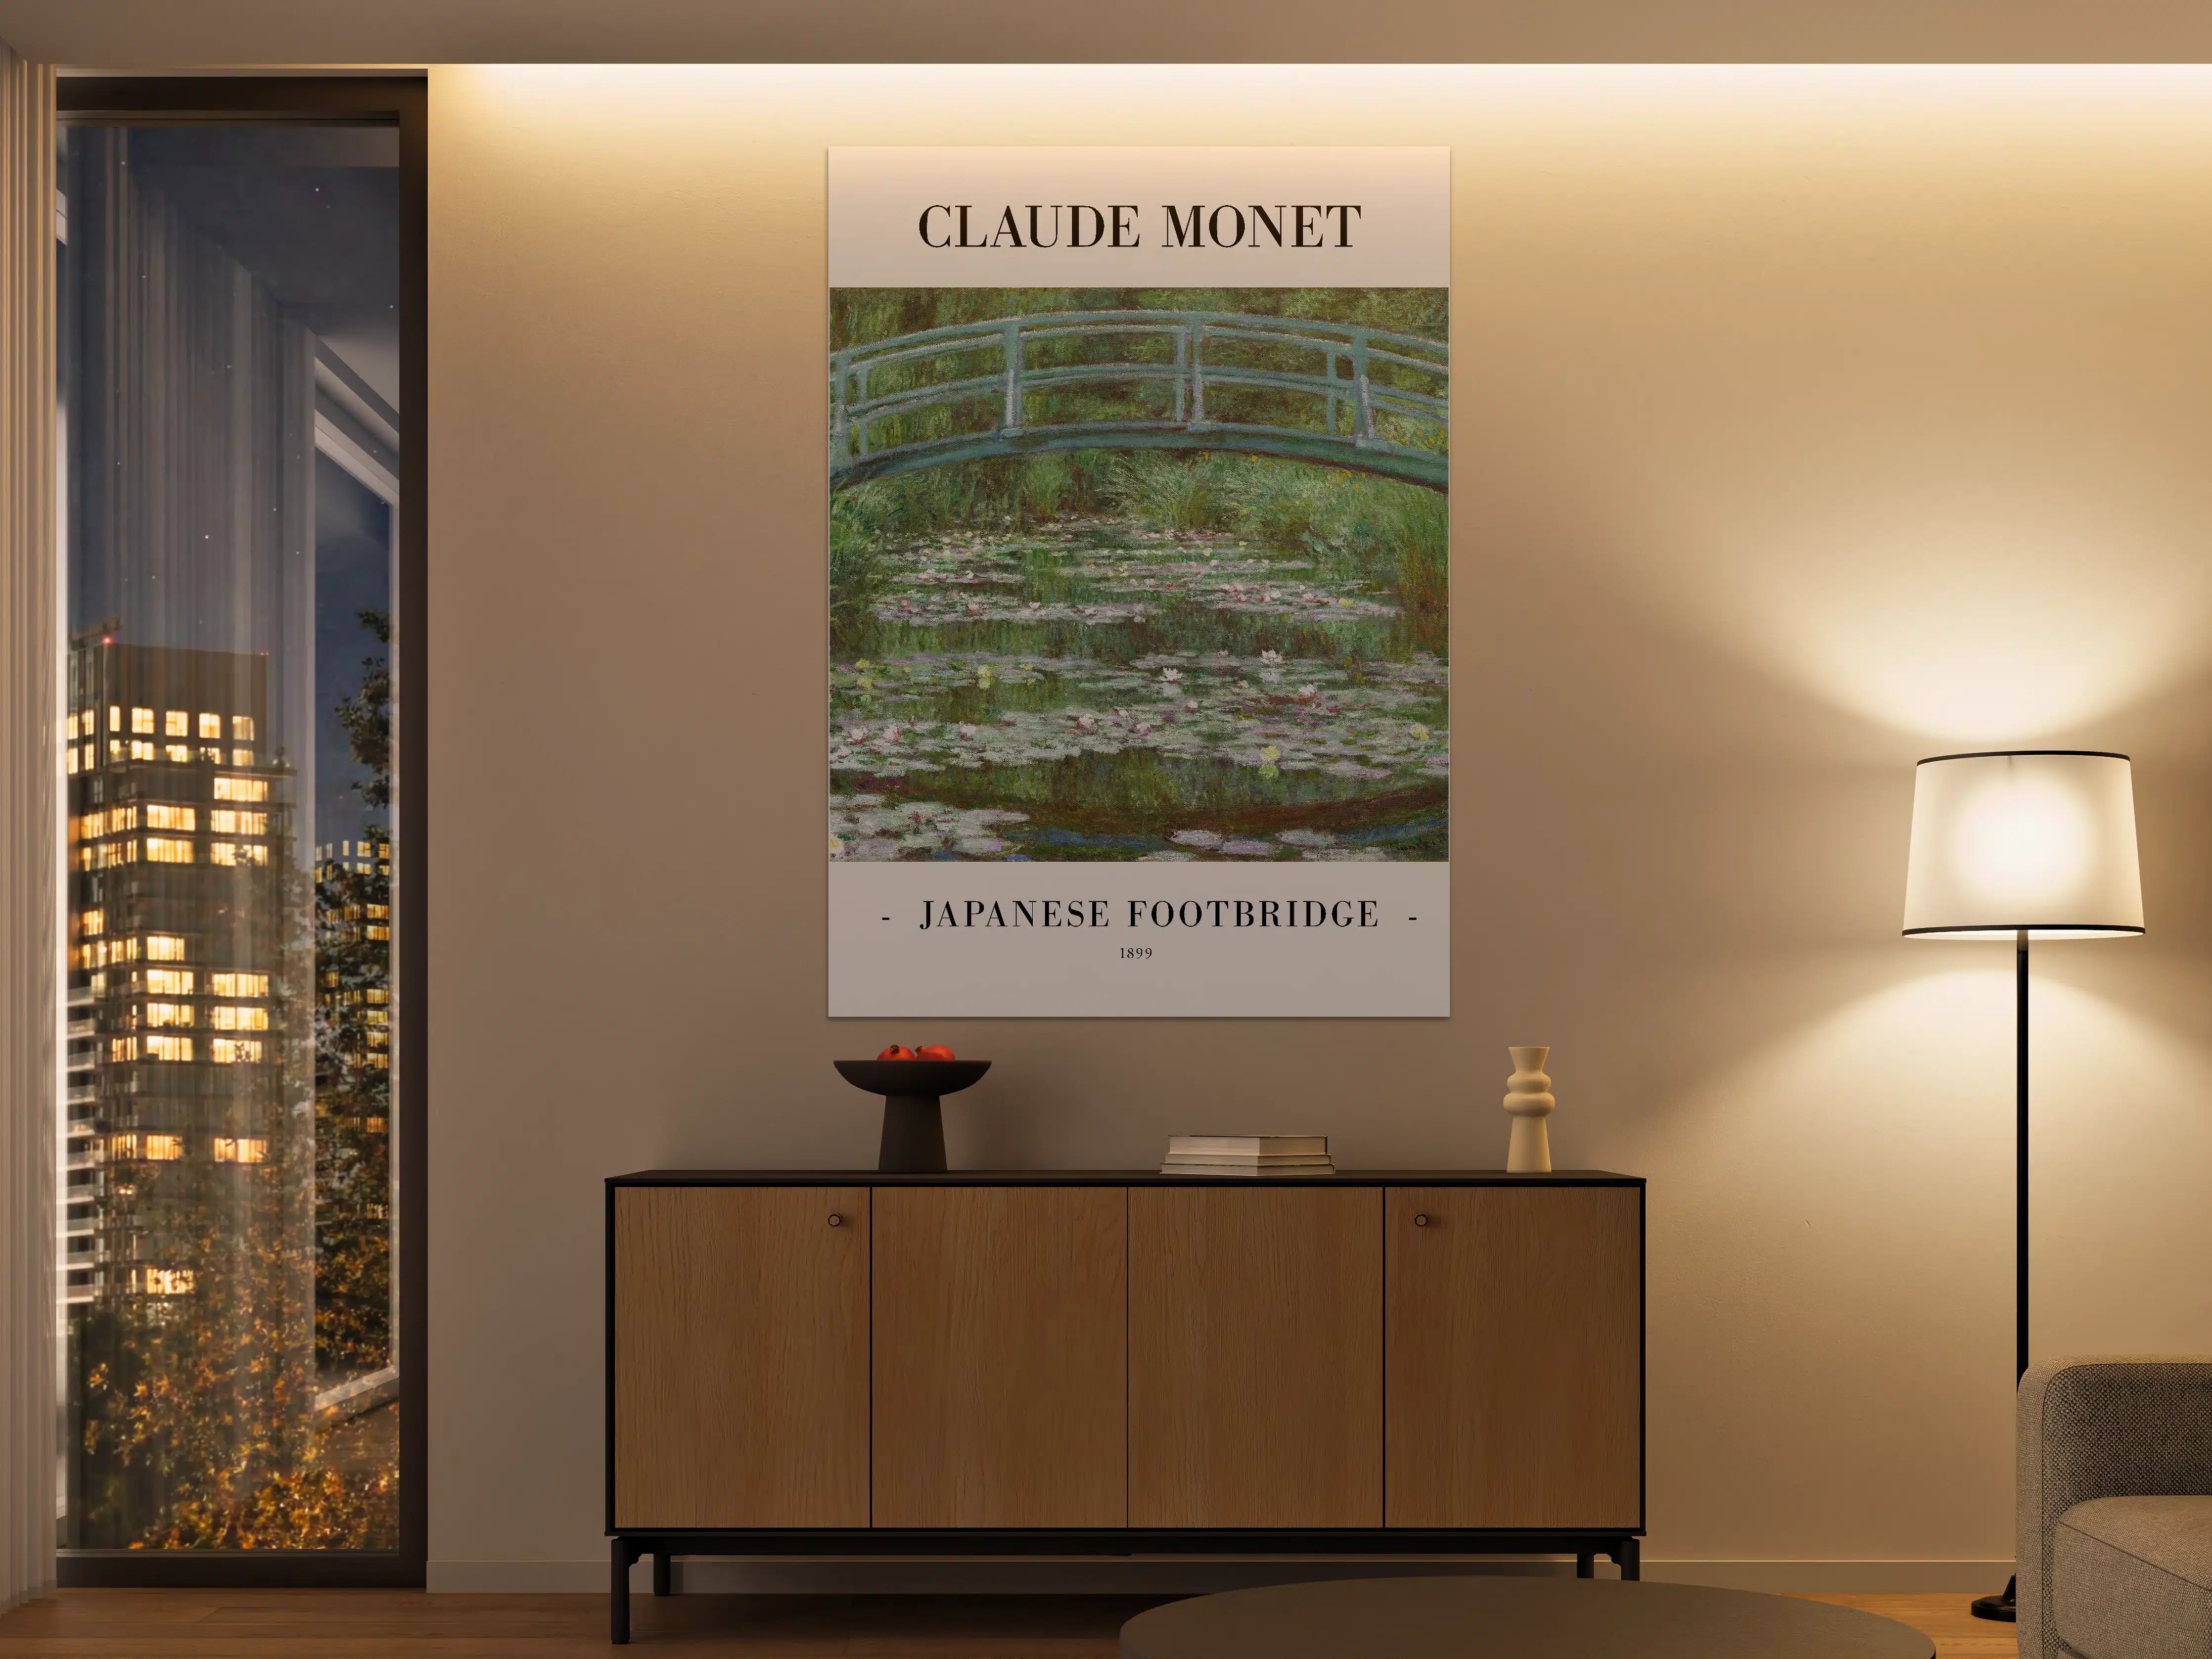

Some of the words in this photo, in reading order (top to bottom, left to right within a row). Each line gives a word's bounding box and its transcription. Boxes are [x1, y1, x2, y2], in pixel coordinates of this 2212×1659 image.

[919, 205, 1140, 248] CLAUDE
[1161, 205, 1361, 248] MONET
[920, 900, 1109, 930] JAPANESE
[1127, 900, 1378, 927] FOOTBRIDGE
[1120, 948, 1152, 959] 1899
